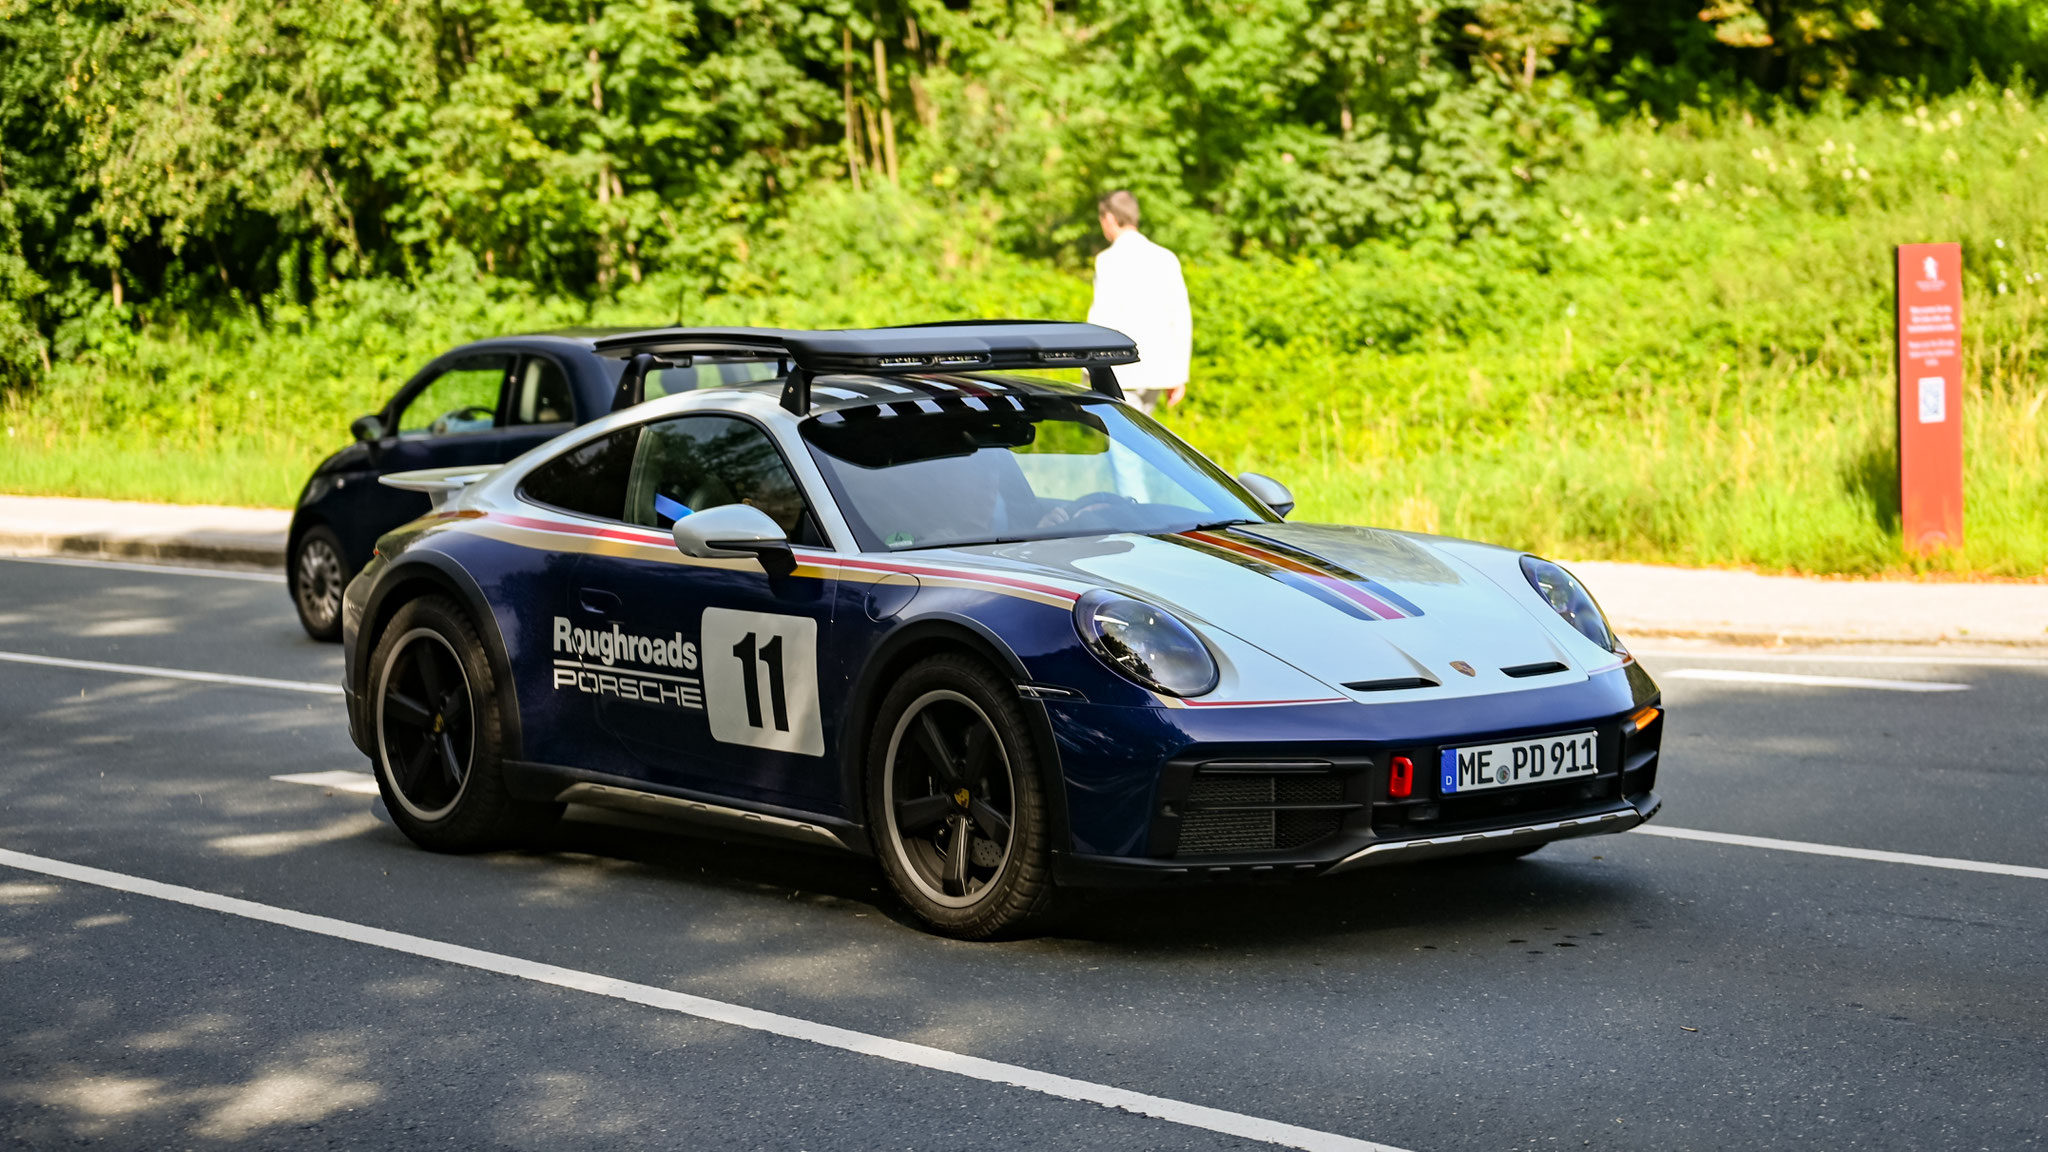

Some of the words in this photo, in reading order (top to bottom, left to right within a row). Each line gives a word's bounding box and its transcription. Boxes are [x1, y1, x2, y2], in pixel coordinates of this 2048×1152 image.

[553, 616, 699, 670] Roughroads
[553, 668, 703, 709] PORSCHE
[733, 632, 790, 732] 11
[1445, 775, 1453, 786] D
[1458, 750, 1494, 786] ME
[1512, 744, 1545, 780] PD
[1551, 738, 1594, 775] 911
